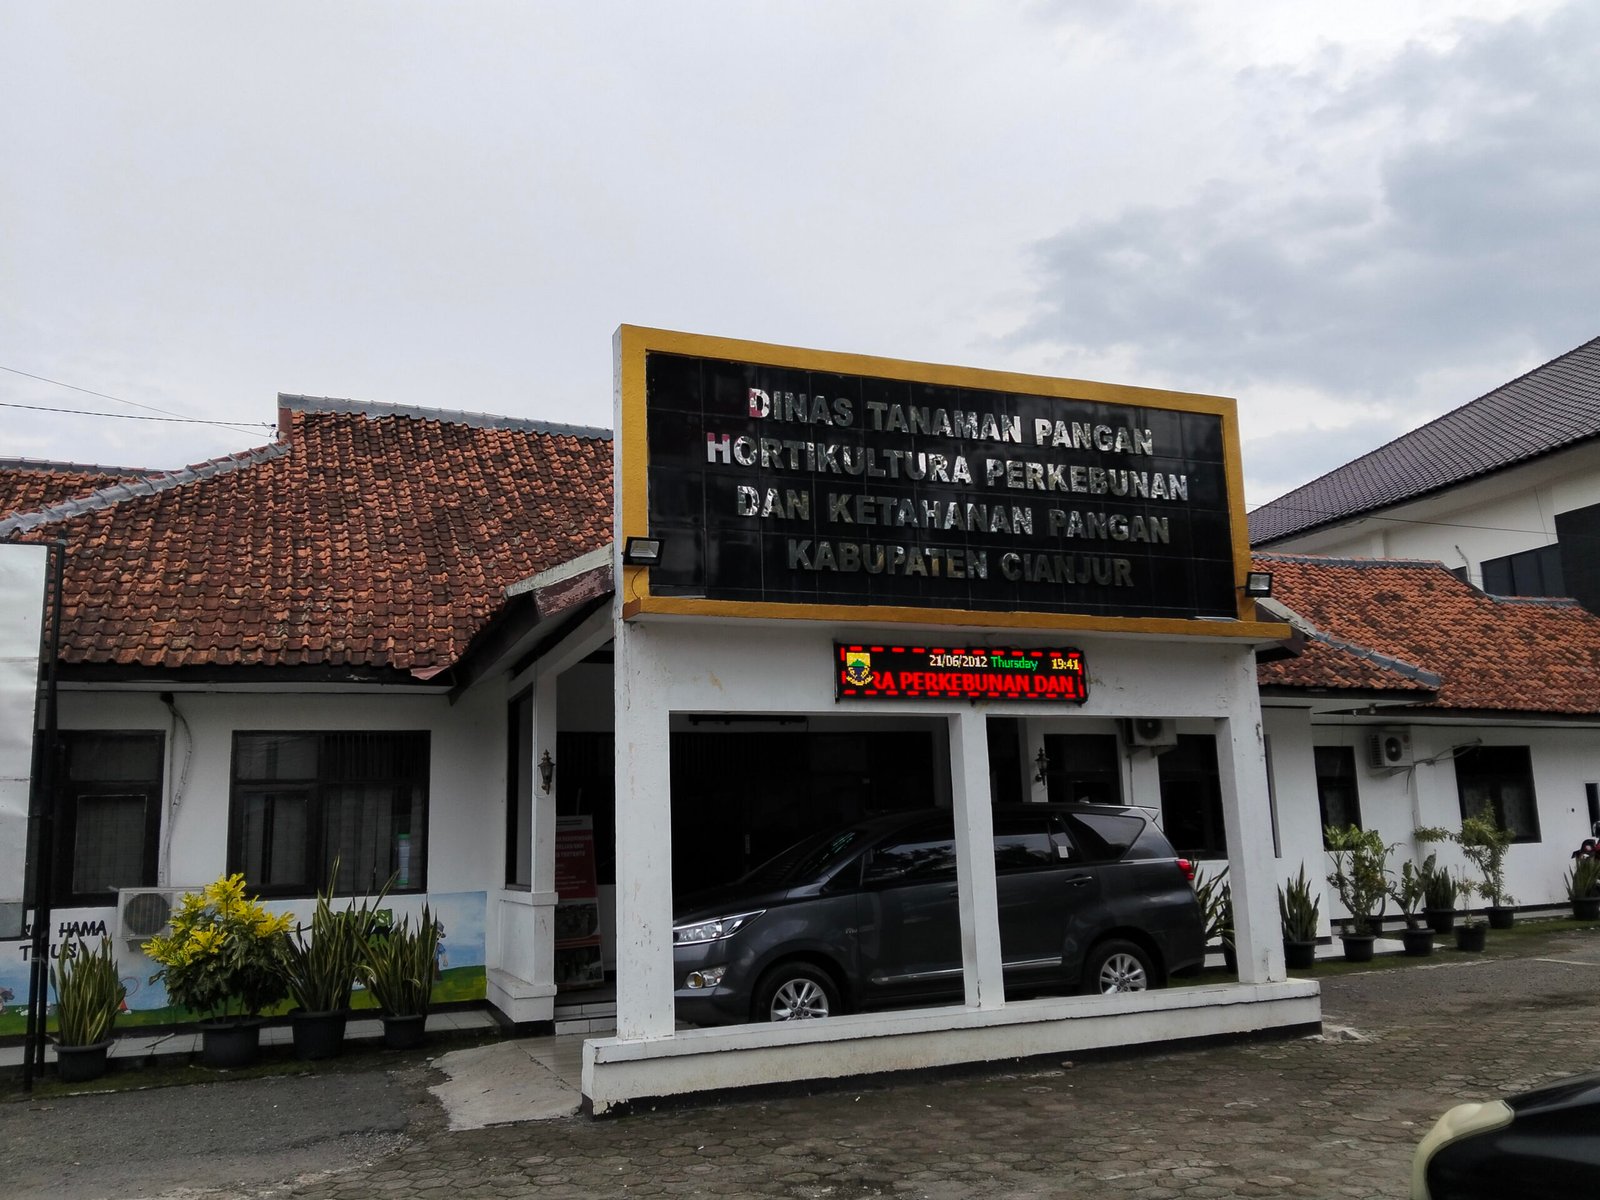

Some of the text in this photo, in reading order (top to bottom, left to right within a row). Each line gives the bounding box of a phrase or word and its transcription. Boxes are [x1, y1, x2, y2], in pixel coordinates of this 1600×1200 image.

[748, 387, 1153, 456] DINAS TANAMAN PANGAN
[706, 432, 1188, 500] HORTIKULTURA PERKEBUNAN
[737, 485, 1170, 545] DAN KETAHANAN PANGAN
[787, 538, 1135, 587] KABUPATEN CIANJUR
[900, 671, 1030, 693] PERKEBUNAN
[1033, 675, 1073, 693] DAN
[929, 654, 1079, 671] 21/06/2012 Thursday 19:41
[59, 920, 107, 938] HAMA
